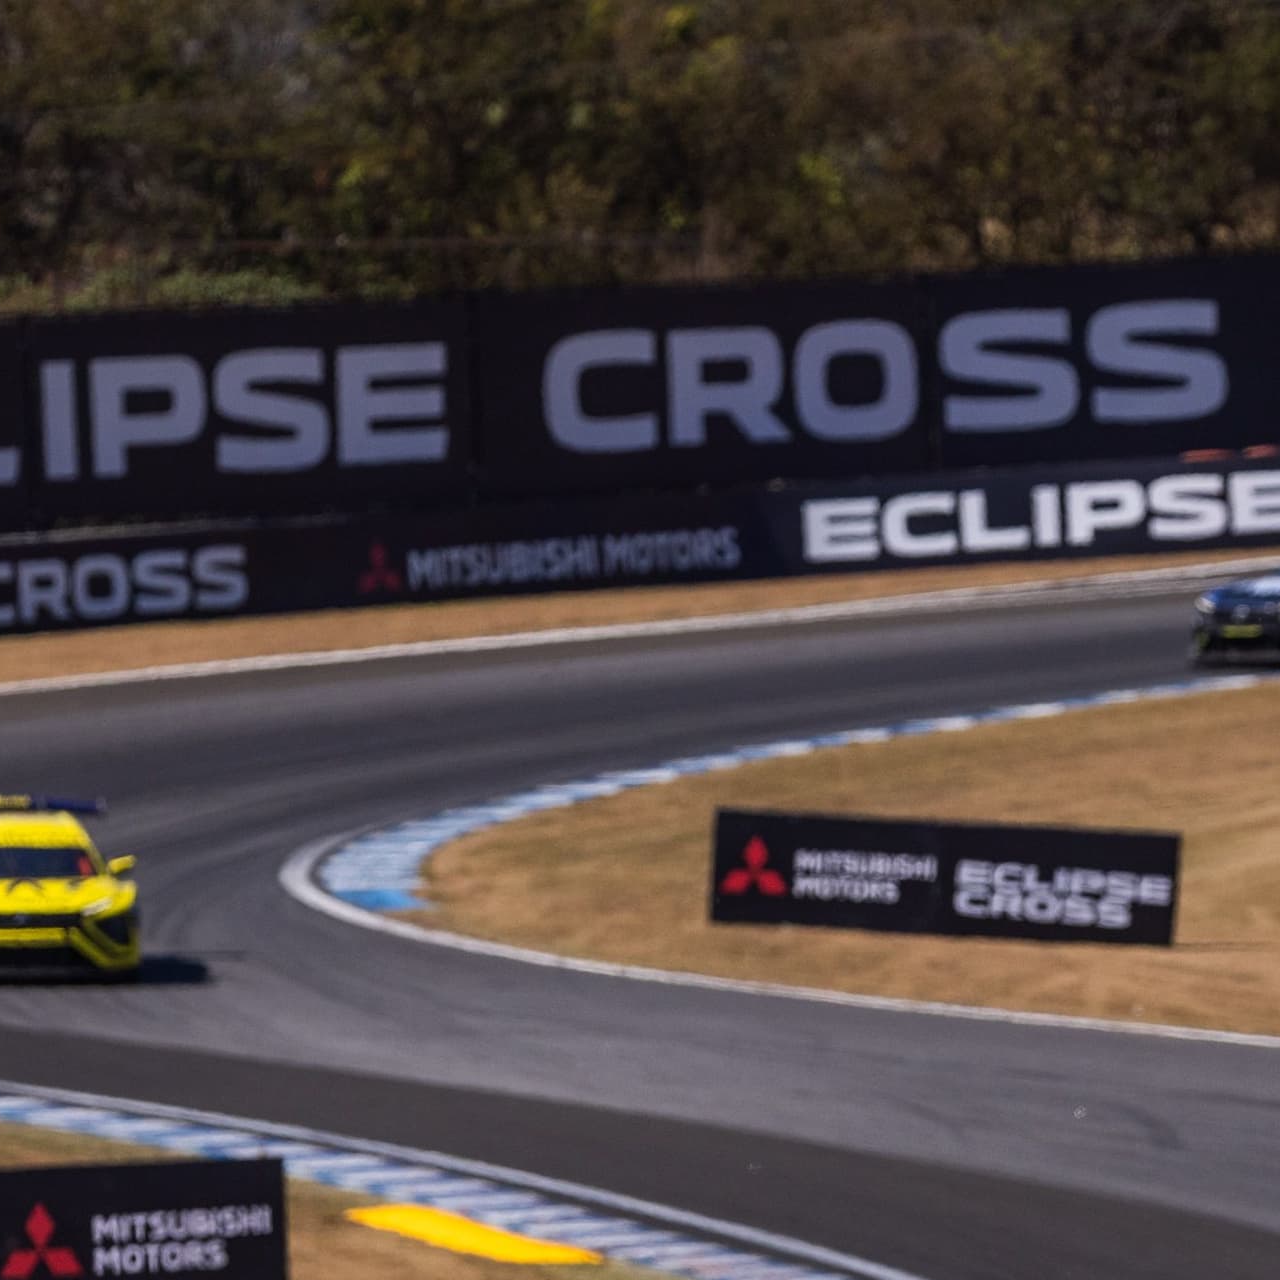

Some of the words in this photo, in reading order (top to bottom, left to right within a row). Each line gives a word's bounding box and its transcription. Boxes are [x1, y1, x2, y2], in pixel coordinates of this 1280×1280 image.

[542, 298, 1229, 454] CROSS
[406, 536, 600, 591] MITSUBISHI
[602, 526, 742, 577] MOTORS
[793, 849, 939, 881] MITSUBISHI
[954, 858, 1173, 906] ECLIPSE
[792, 874, 902, 903] MOTORS
[953, 890, 1132, 929] CROSS
[90, 1204, 273, 1242] MITSUBISHI
[91, 1241, 229, 1276] MOTORS
